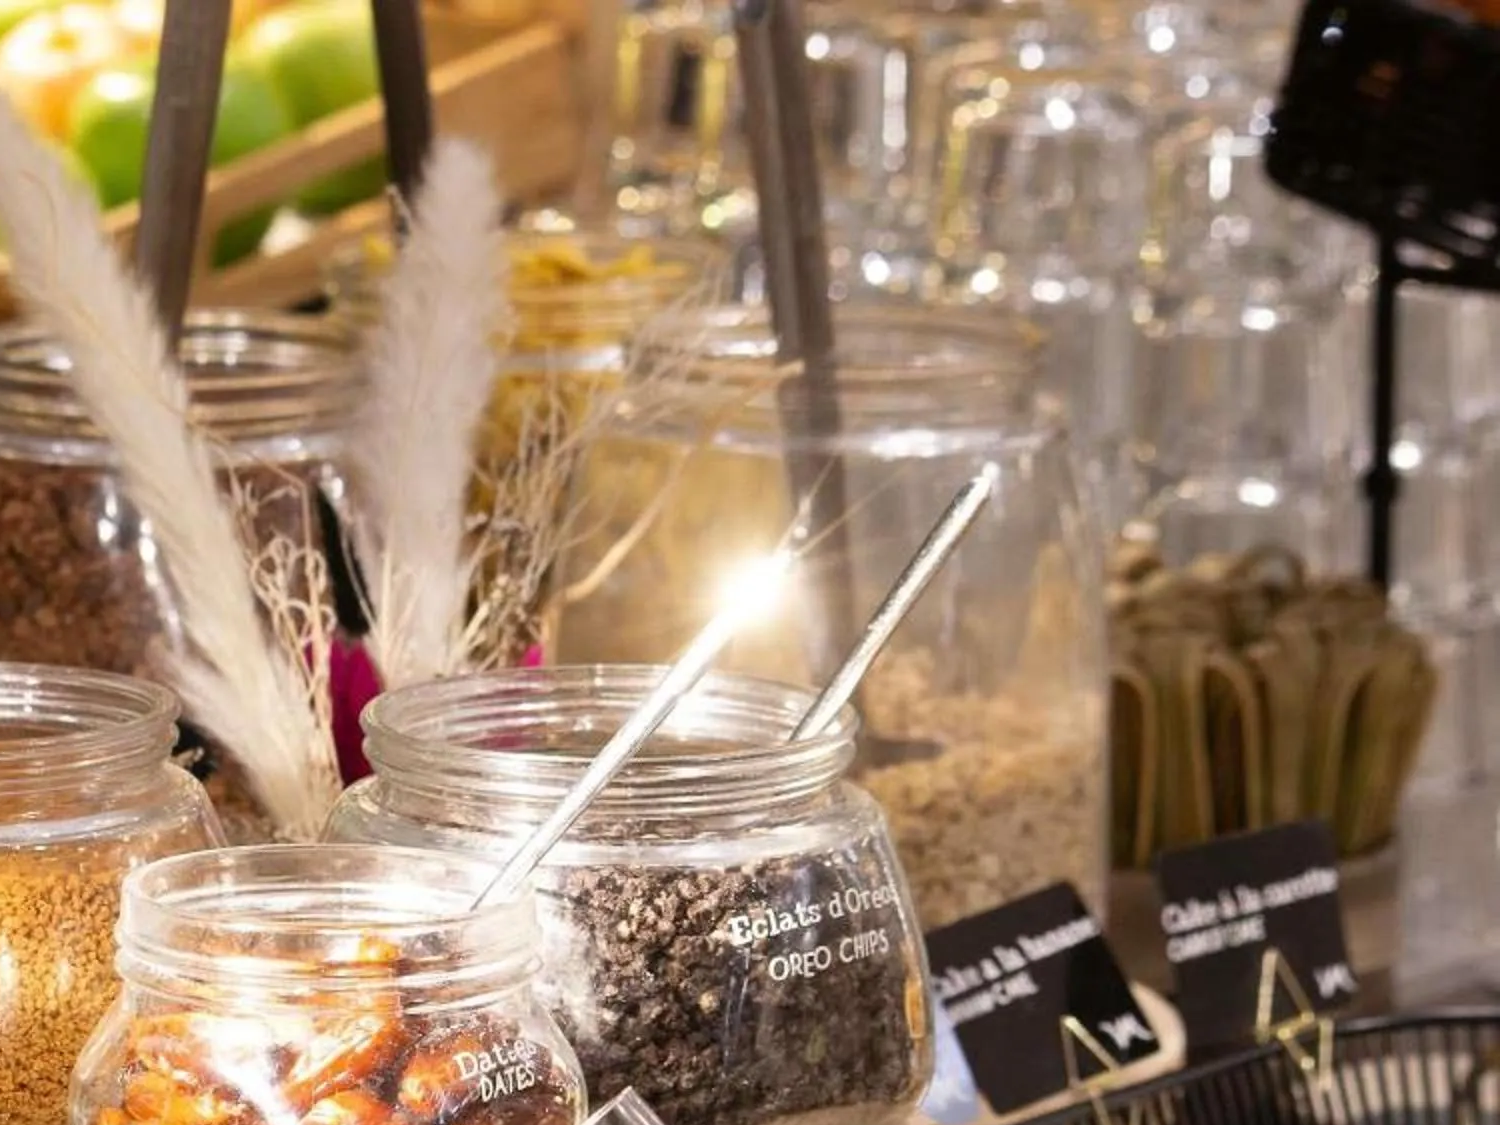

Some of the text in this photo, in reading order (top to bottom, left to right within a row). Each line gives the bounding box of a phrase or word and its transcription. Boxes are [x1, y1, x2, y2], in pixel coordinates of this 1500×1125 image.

[768, 928, 890, 982] OREO CHIPS
[479, 1063, 535, 1103] DATES
